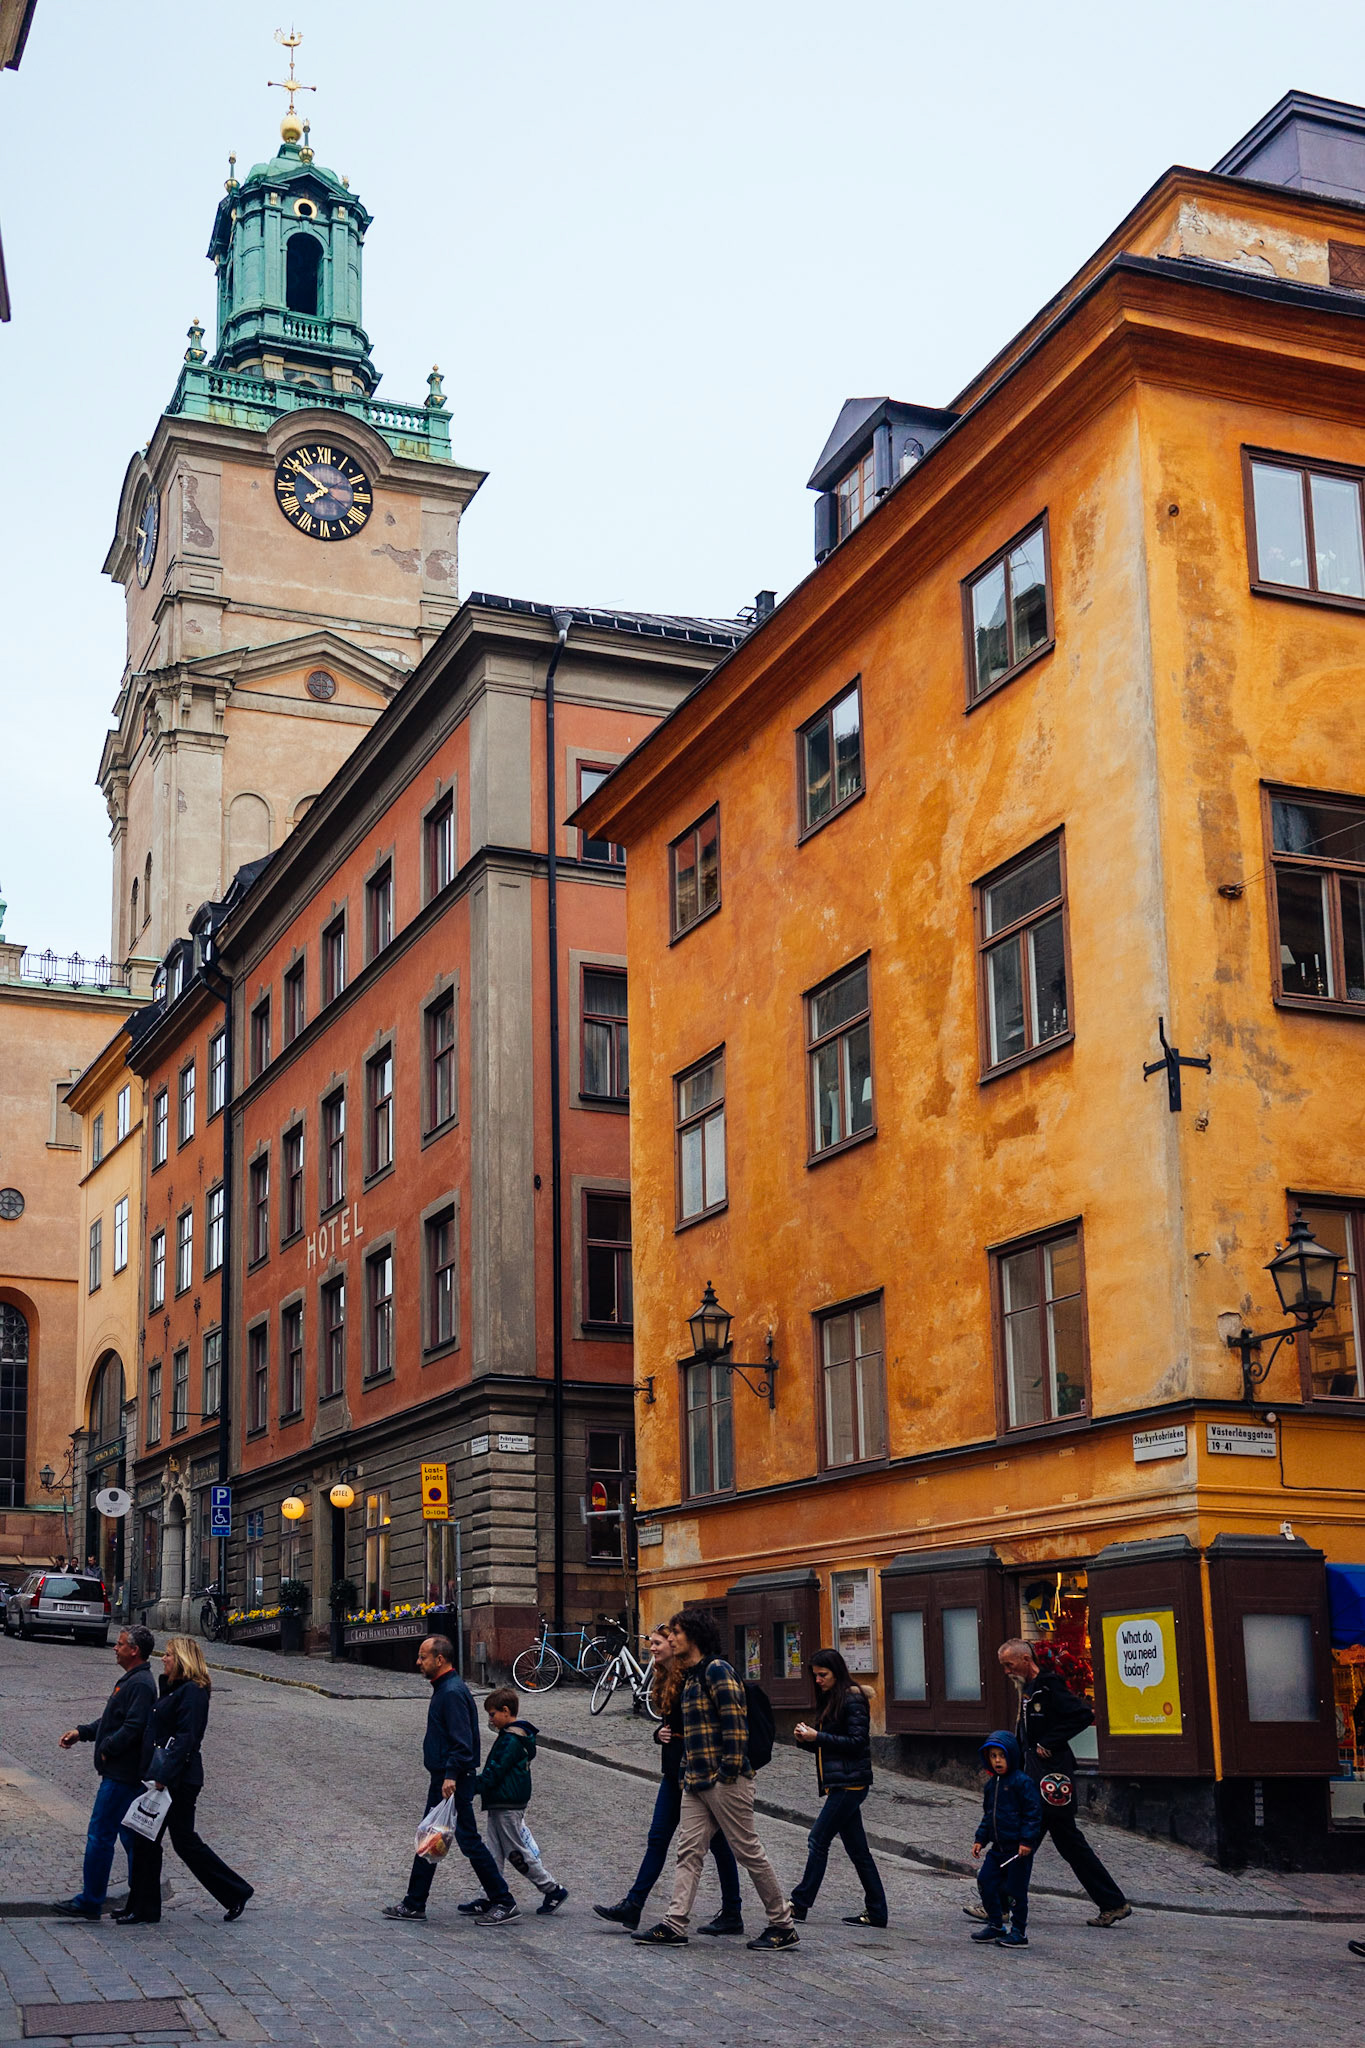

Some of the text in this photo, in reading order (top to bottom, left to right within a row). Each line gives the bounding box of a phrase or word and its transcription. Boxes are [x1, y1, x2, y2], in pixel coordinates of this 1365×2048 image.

[296, 448, 313, 467] XI
[316, 446, 331, 465] XII
[348, 474, 366, 485] II
[354, 492, 371, 504] III
[307, 1202, 363, 1270] HOTEL
[1134, 1429, 1184, 1444] Storkyrkobrinken
[1211, 1427, 1273, 1440] Västerlånggatan
[217, 1489, 227, 1504] P
[399, 1625, 418, 1635] HOTEL
[1121, 1630, 1152, 1644] What do
[1123, 1646, 1156, 1663] you need
[1124, 1662, 1149, 1678] today?
